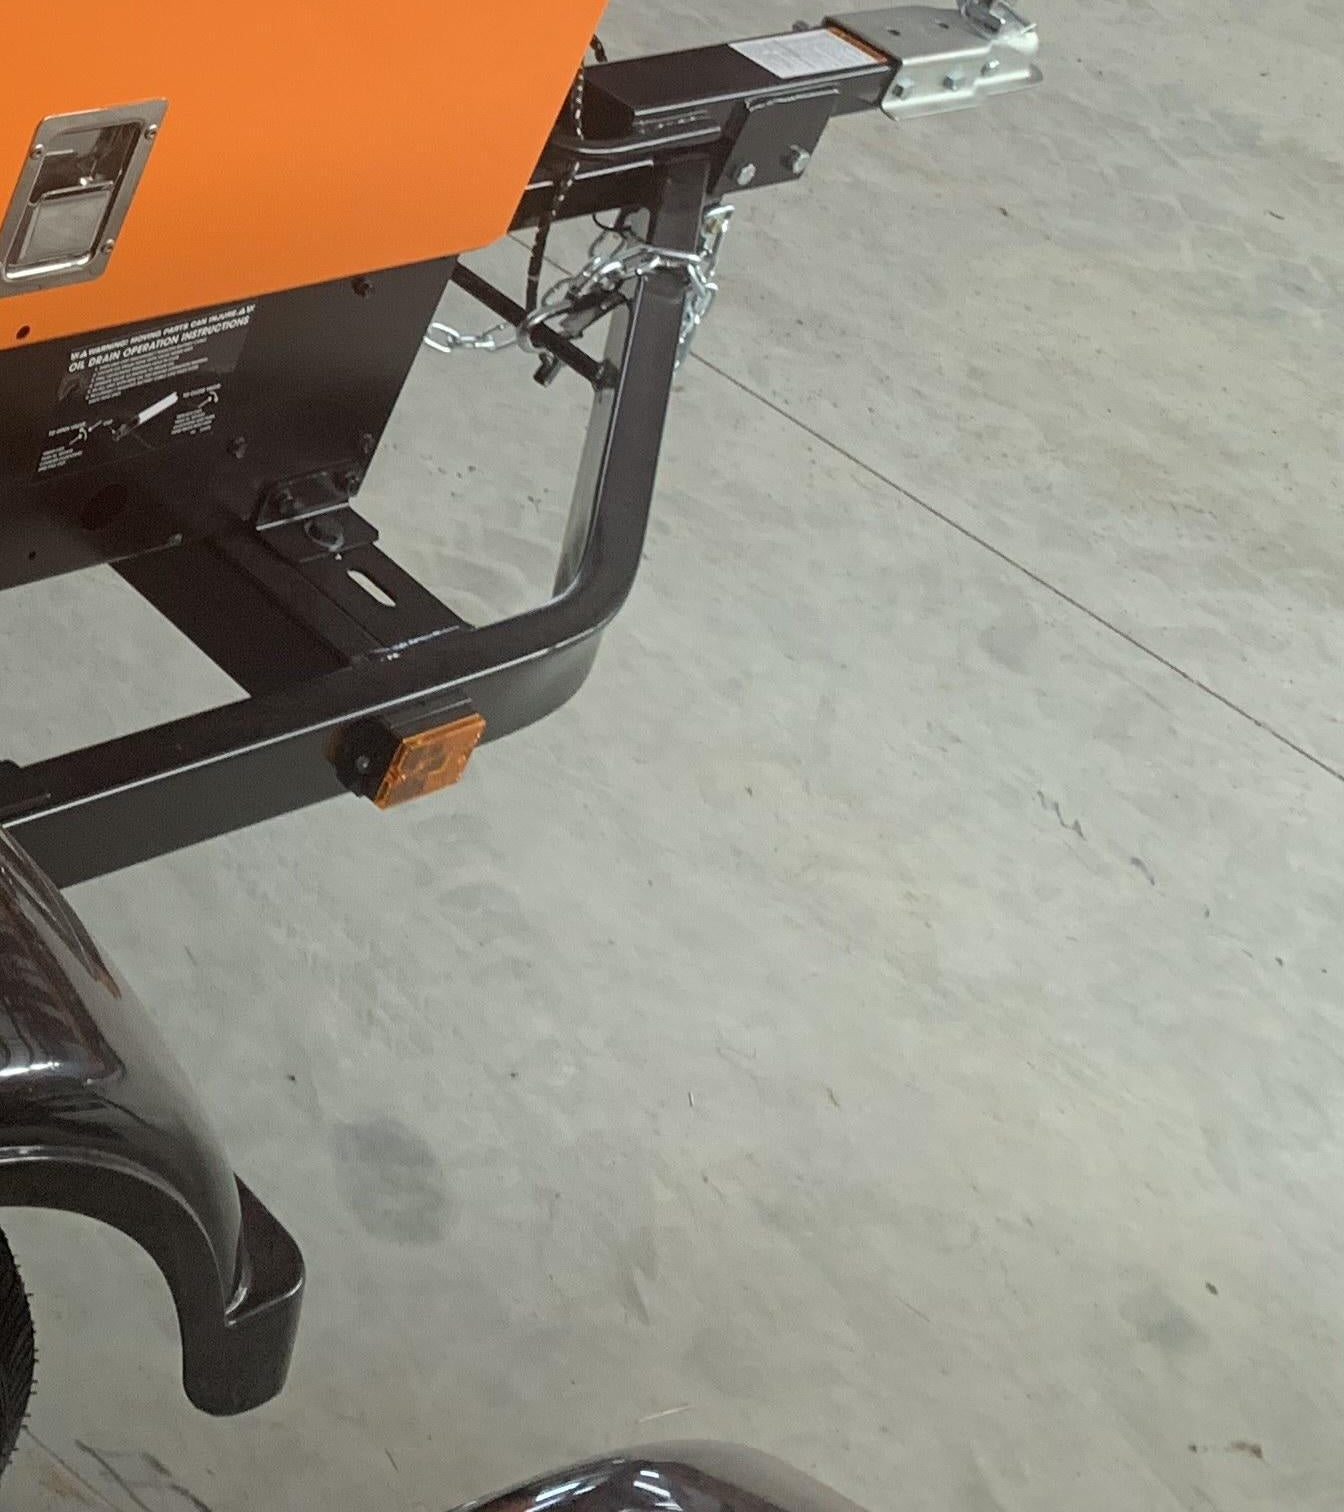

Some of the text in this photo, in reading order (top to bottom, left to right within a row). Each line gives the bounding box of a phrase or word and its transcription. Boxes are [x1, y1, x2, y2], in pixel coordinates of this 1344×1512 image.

[69, 315, 250, 372] OIL DRAIN OPERATION INSTRUCTIONS
